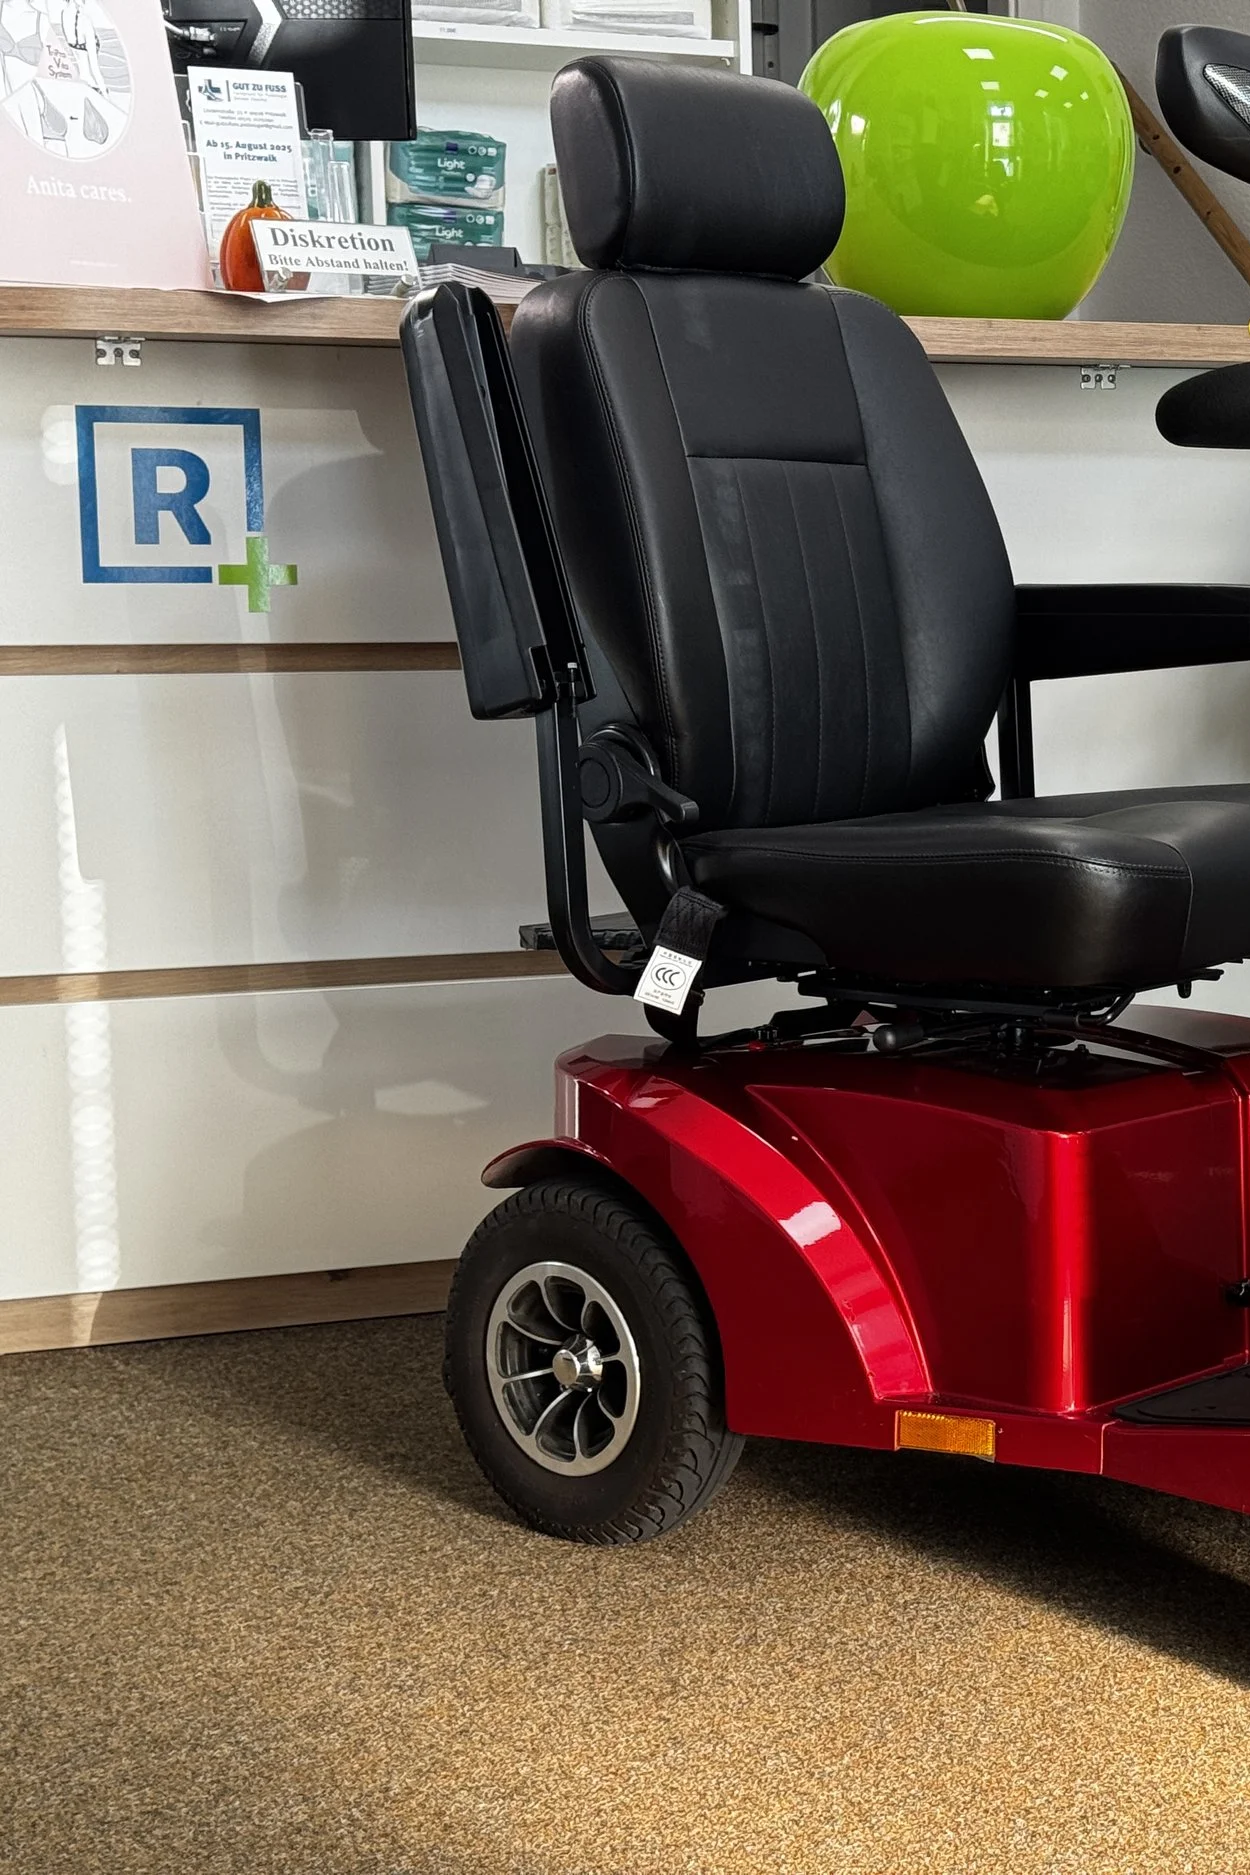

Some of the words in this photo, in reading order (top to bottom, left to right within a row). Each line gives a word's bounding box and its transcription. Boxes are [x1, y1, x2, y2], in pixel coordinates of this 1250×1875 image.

[232, 82, 250, 91] GUT
[251, 83, 263, 91] ZU
[265, 84, 287, 93] FUSS
[206, 139, 218, 147] Ab
[235, 141, 267, 151] August
[270, 144, 293, 153] 2025
[235, 152, 278, 162] Pritzwalk
[437, 158, 466, 170] Light
[26, 174, 77, 198] Anita
[80, 183, 132, 203] cares.
[268, 227, 395, 252] Diskretion
[435, 226, 464, 239] Light
[268, 254, 301, 266] Bitte
[305, 256, 360, 269] Abstand
[363, 259, 409, 271] halten!
[131, 447, 212, 545] R
